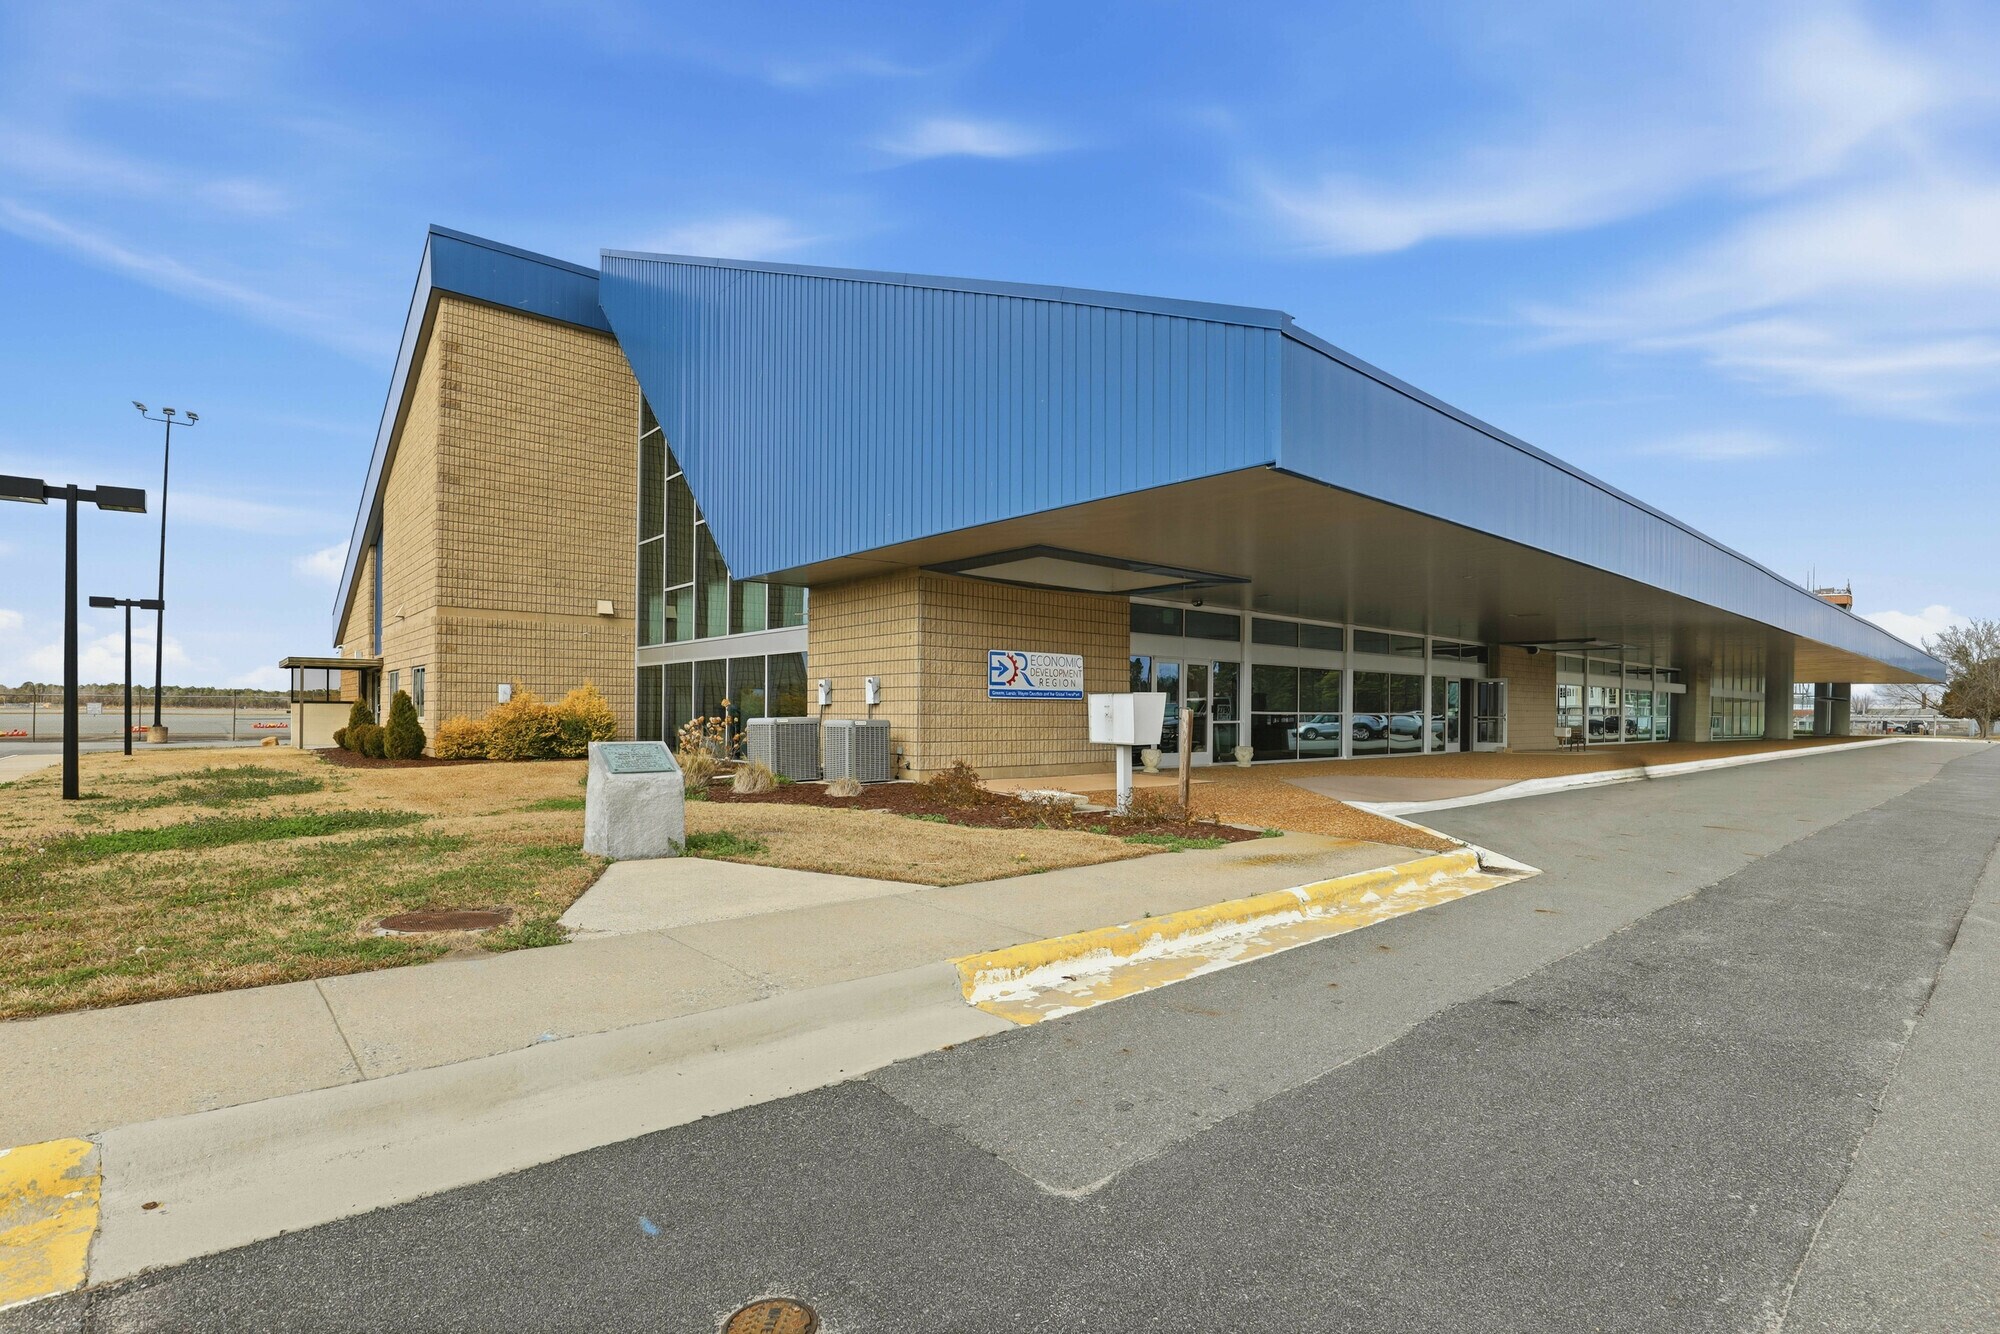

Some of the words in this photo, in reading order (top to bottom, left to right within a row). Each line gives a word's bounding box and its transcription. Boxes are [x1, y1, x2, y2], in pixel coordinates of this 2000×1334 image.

[1030, 655, 1082, 669] ECONOMIC
[1030, 668, 1082, 678] DEVELOPMENT
[1039, 678, 1076, 688] REGION
